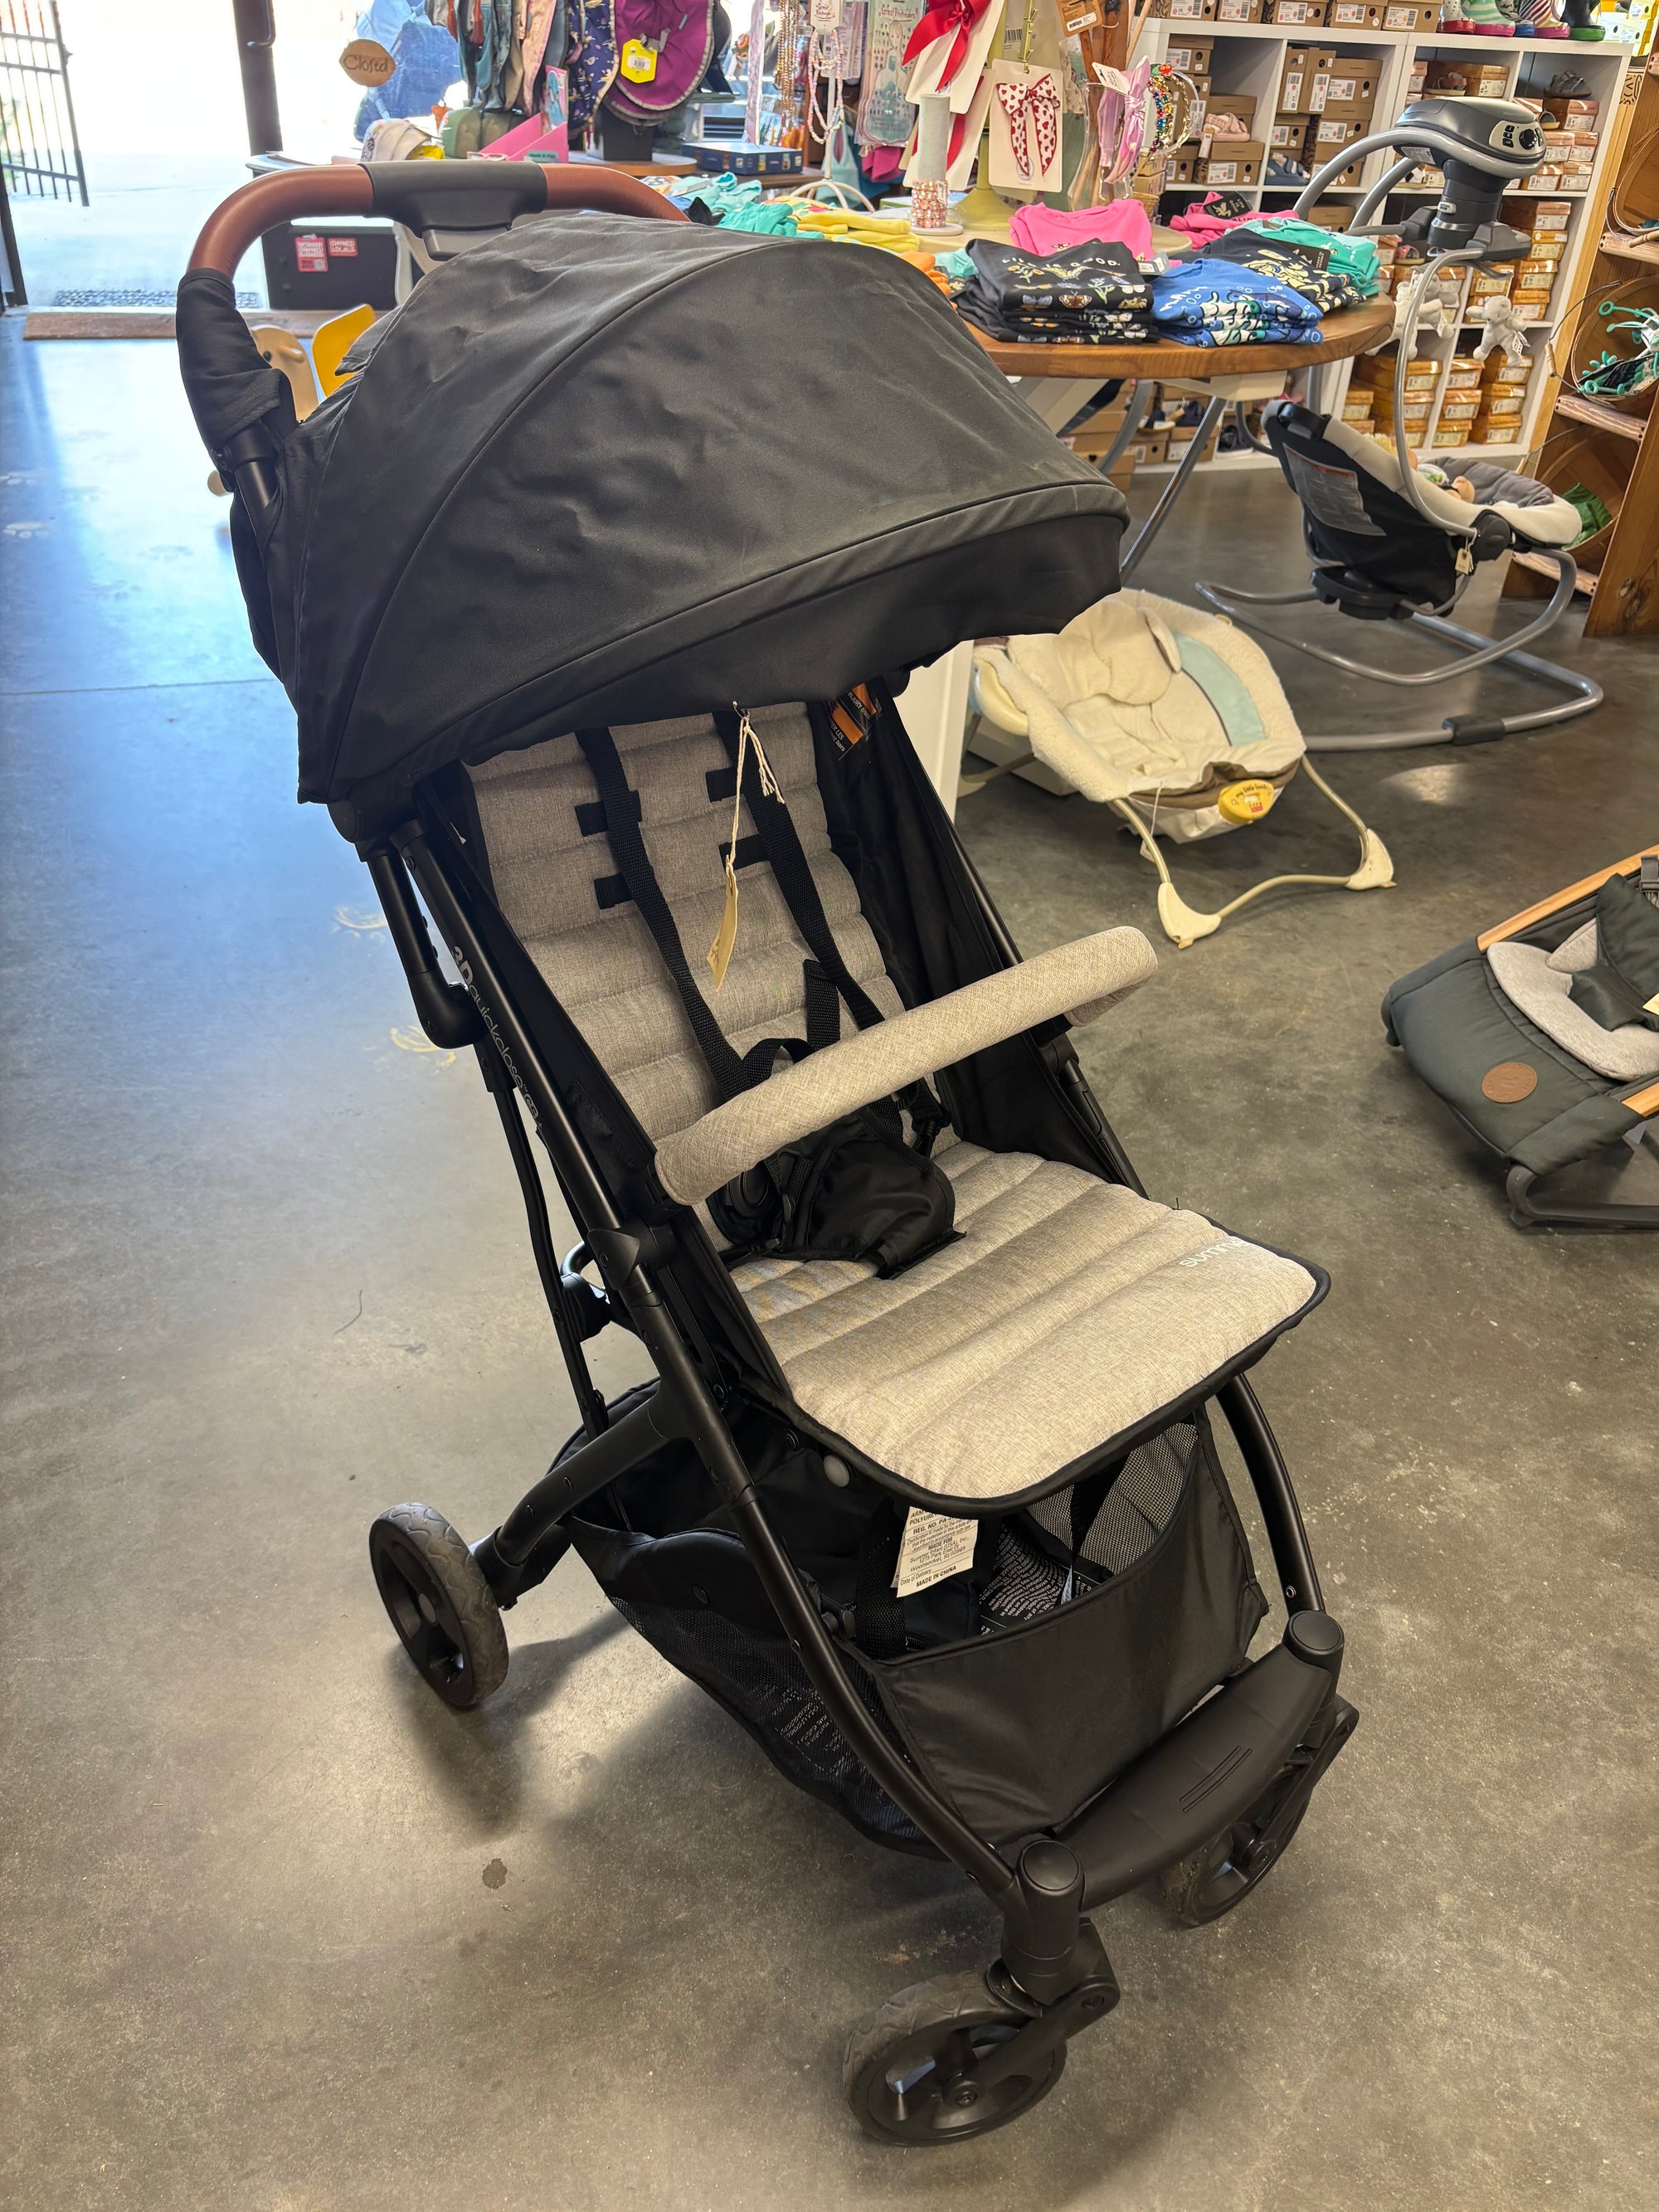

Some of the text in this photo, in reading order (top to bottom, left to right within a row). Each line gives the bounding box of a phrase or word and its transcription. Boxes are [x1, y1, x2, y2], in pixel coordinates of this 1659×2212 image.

[343, 55, 388, 73] Closed
[1180, 1241, 1250, 1267] summe
[910, 1514, 937, 1525] POLYURE
[928, 1541, 942, 1550] MADE
[901, 1578, 910, 1586] Date
[916, 1569, 932, 1579] Delivery
[917, 1576, 932, 1587] MADE
[940, 1566, 956, 1577] CHINA
